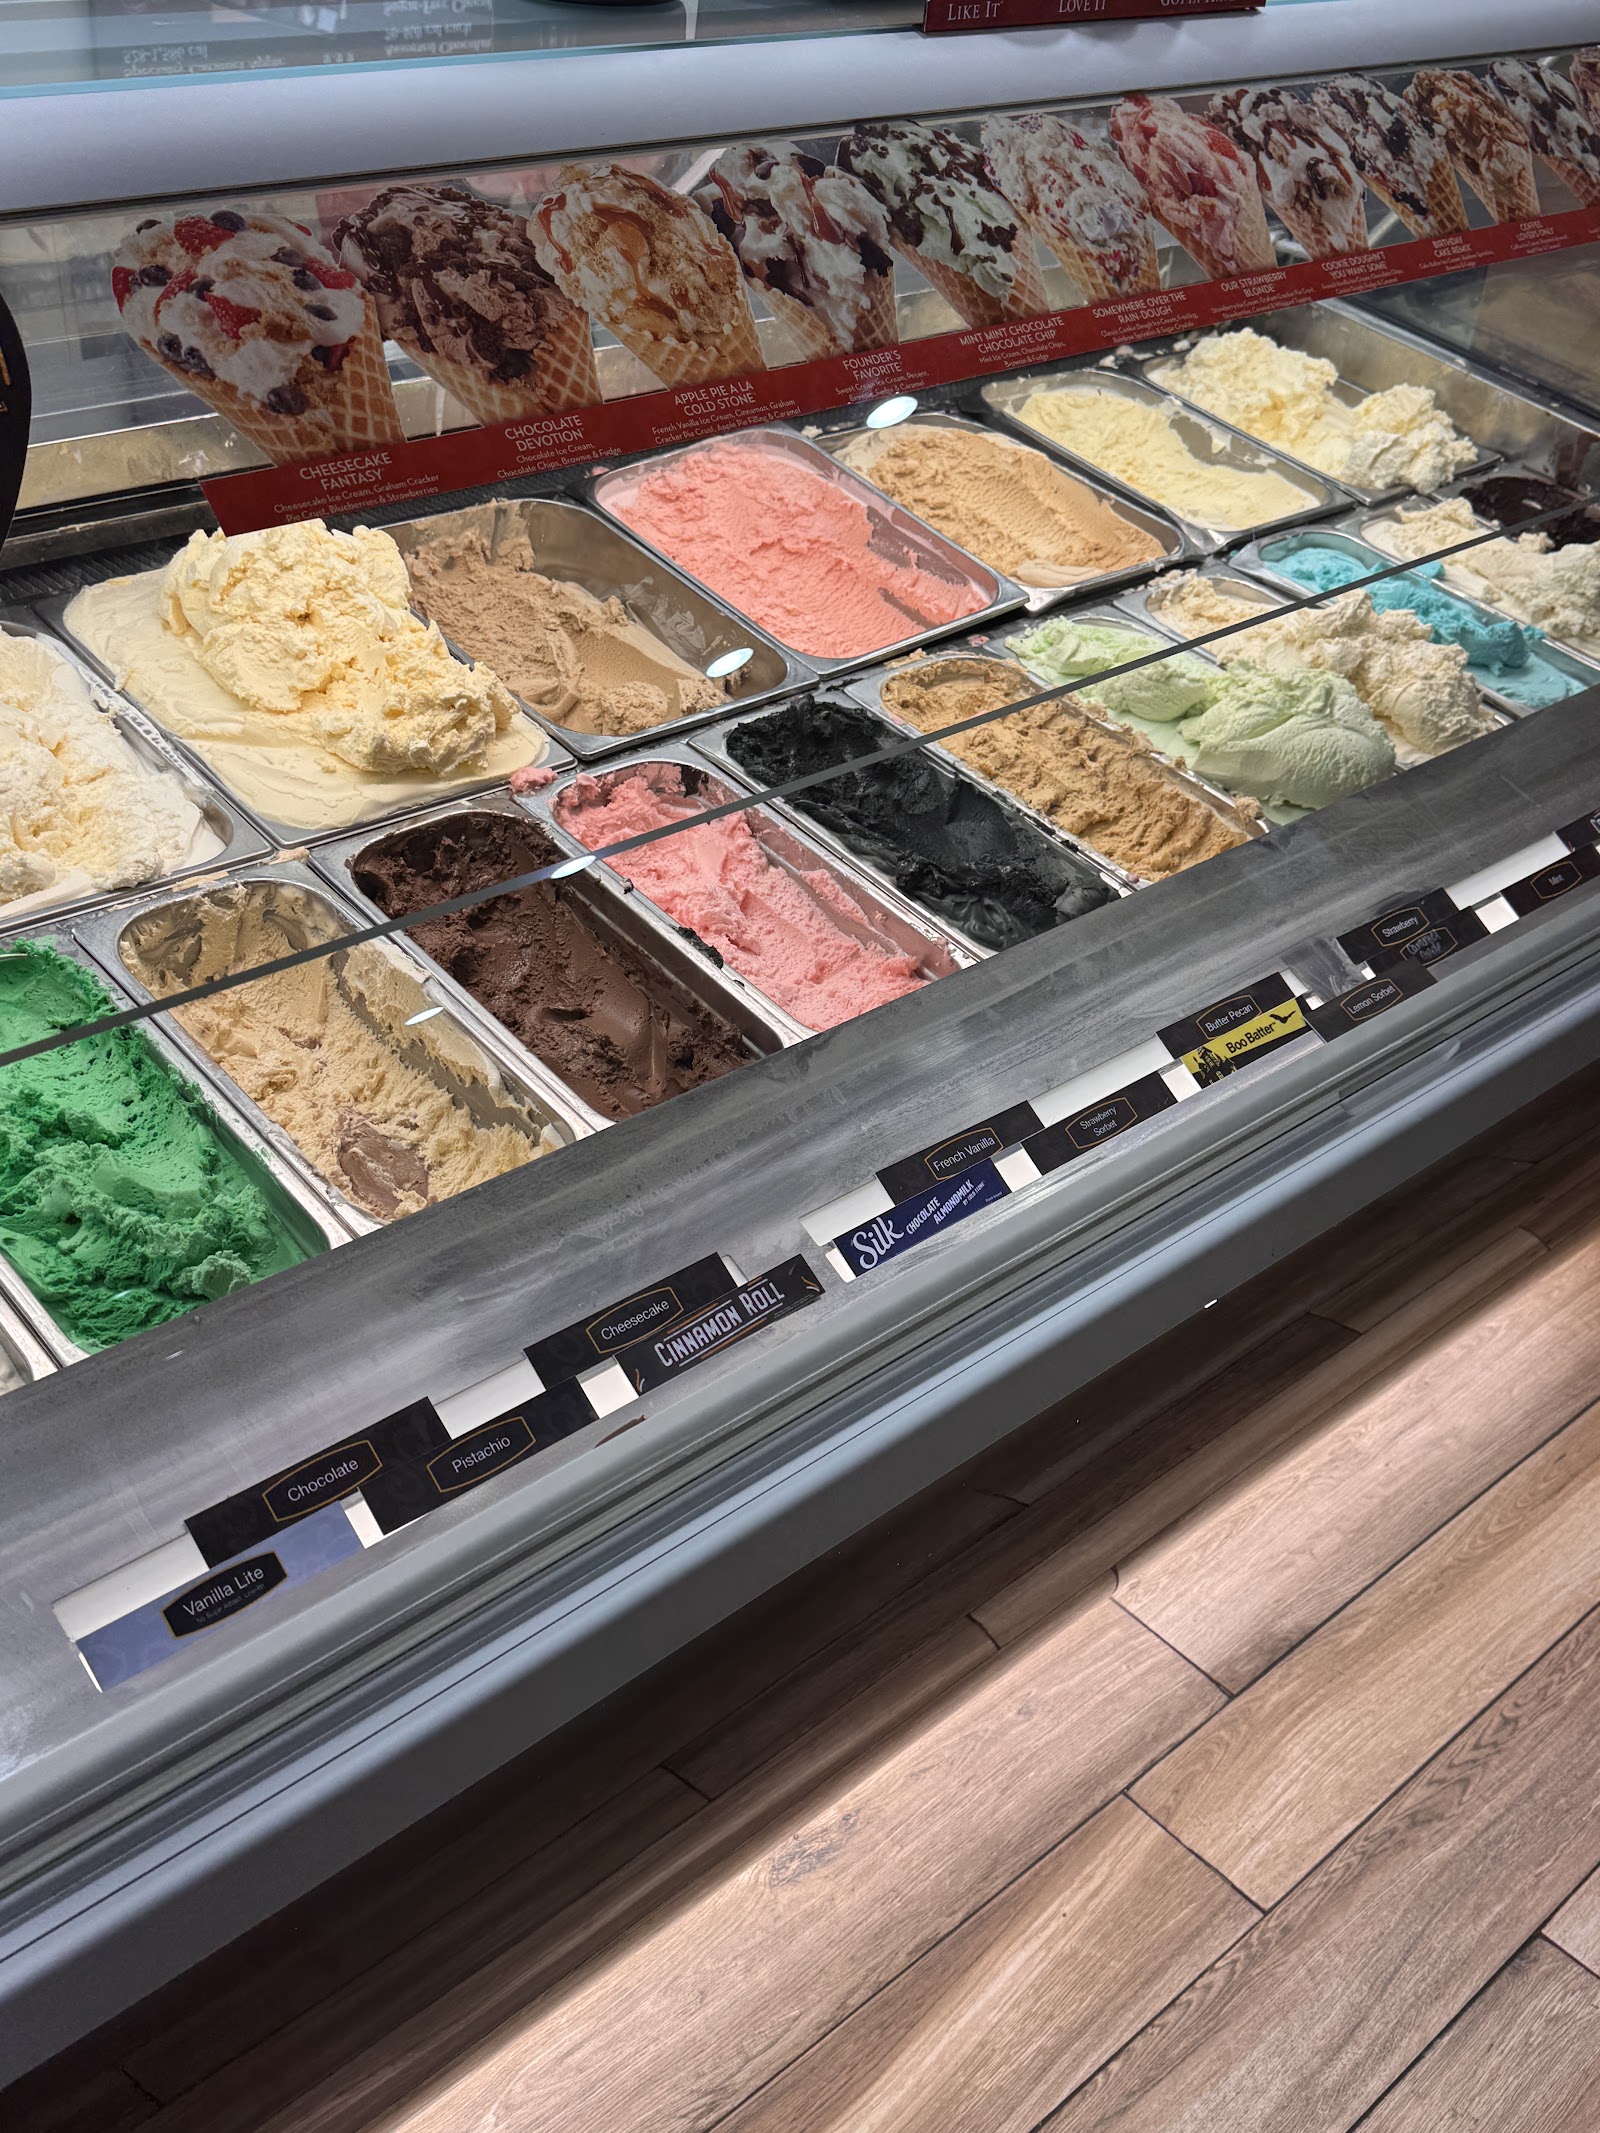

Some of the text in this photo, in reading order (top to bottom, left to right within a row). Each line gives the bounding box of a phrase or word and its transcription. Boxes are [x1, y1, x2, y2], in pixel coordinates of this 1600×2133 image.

[947, 4, 980, 21] LIKE
[1059, 0, 1092, 13] LOVE
[1321, 258, 1349, 272] COOKIE
[1330, 261, 1387, 280] YOU WANT SOME
[1221, 271, 1287, 292] OUR STRAWBERRY
[1244, 284, 1275, 297] BLONDE
[1093, 291, 1187, 318] SOMEWHERE OVER THE
[959, 317, 1064, 346] MINT MINT CHOCOLATE
[978, 329, 1056, 354] CHOCOLATE CHIP
[843, 350, 901, 371] FOUNDER'S
[853, 361, 902, 381] FAVORITE
[674, 381, 754, 406] APPLE PIE A LA
[684, 393, 755, 416] COLD STONE
[505, 415, 583, 440] CHOCOLATE
[652, 421, 677, 435] French
[677, 416, 700, 429] Vanilla
[700, 415, 710, 425] Ice
[770, 399, 796, 409] Graham
[655, 432, 683, 445] Cracker
[774, 407, 801, 418] Caramel
[516, 428, 584, 452] DEVOTION
[300, 452, 392, 480] CHEESECAKE
[497, 464, 537, 479] Chocolate
[562, 453, 591, 465] Brownie
[599, 446, 622, 458] Fudge
[516, 447, 555, 463] Chocolate
[556, 447, 567, 456] Ice
[320, 468, 383, 491] FANTASY
[274, 497, 327, 513] Cheesecake
[328, 493, 341, 503] Ice
[373, 480, 407, 493] Graham
[407, 474, 440, 486] Cracker
[286, 512, 300, 523] Pie
[331, 499, 378, 514] Blueberries
[379, 495, 386, 504] &
[387, 486, 439, 501] Strawberries
[1548, 874, 1565, 886] Mint
[1382, 916, 1418, 938] Strawberry
[1347, 985, 1396, 1014] Lemon Sorbet
[1205, 1004, 1253, 1032] Butter Pecan
[1225, 1038, 1247, 1054] Boo
[1079, 1106, 1117, 1130] Strawberry
[1093, 1119, 1118, 1137] Sorbet
[933, 1135, 996, 1172] French Vanilla
[933, 1179, 974, 1225] ALMONDMILK
[906, 1196, 941, 1235] CHOCOLATE
[852, 1217, 904, 1270] Silk
[600, 1298, 670, 1341] Cheesecake
[653, 1305, 743, 1368] CINNAMON
[740, 1281, 785, 1316] ROLL
[451, 1435, 511, 1474] Pistachio
[287, 1457, 359, 1503] Chocolate
[183, 1586, 235, 1616] Vanilla
[234, 1568, 264, 1589] Lite
